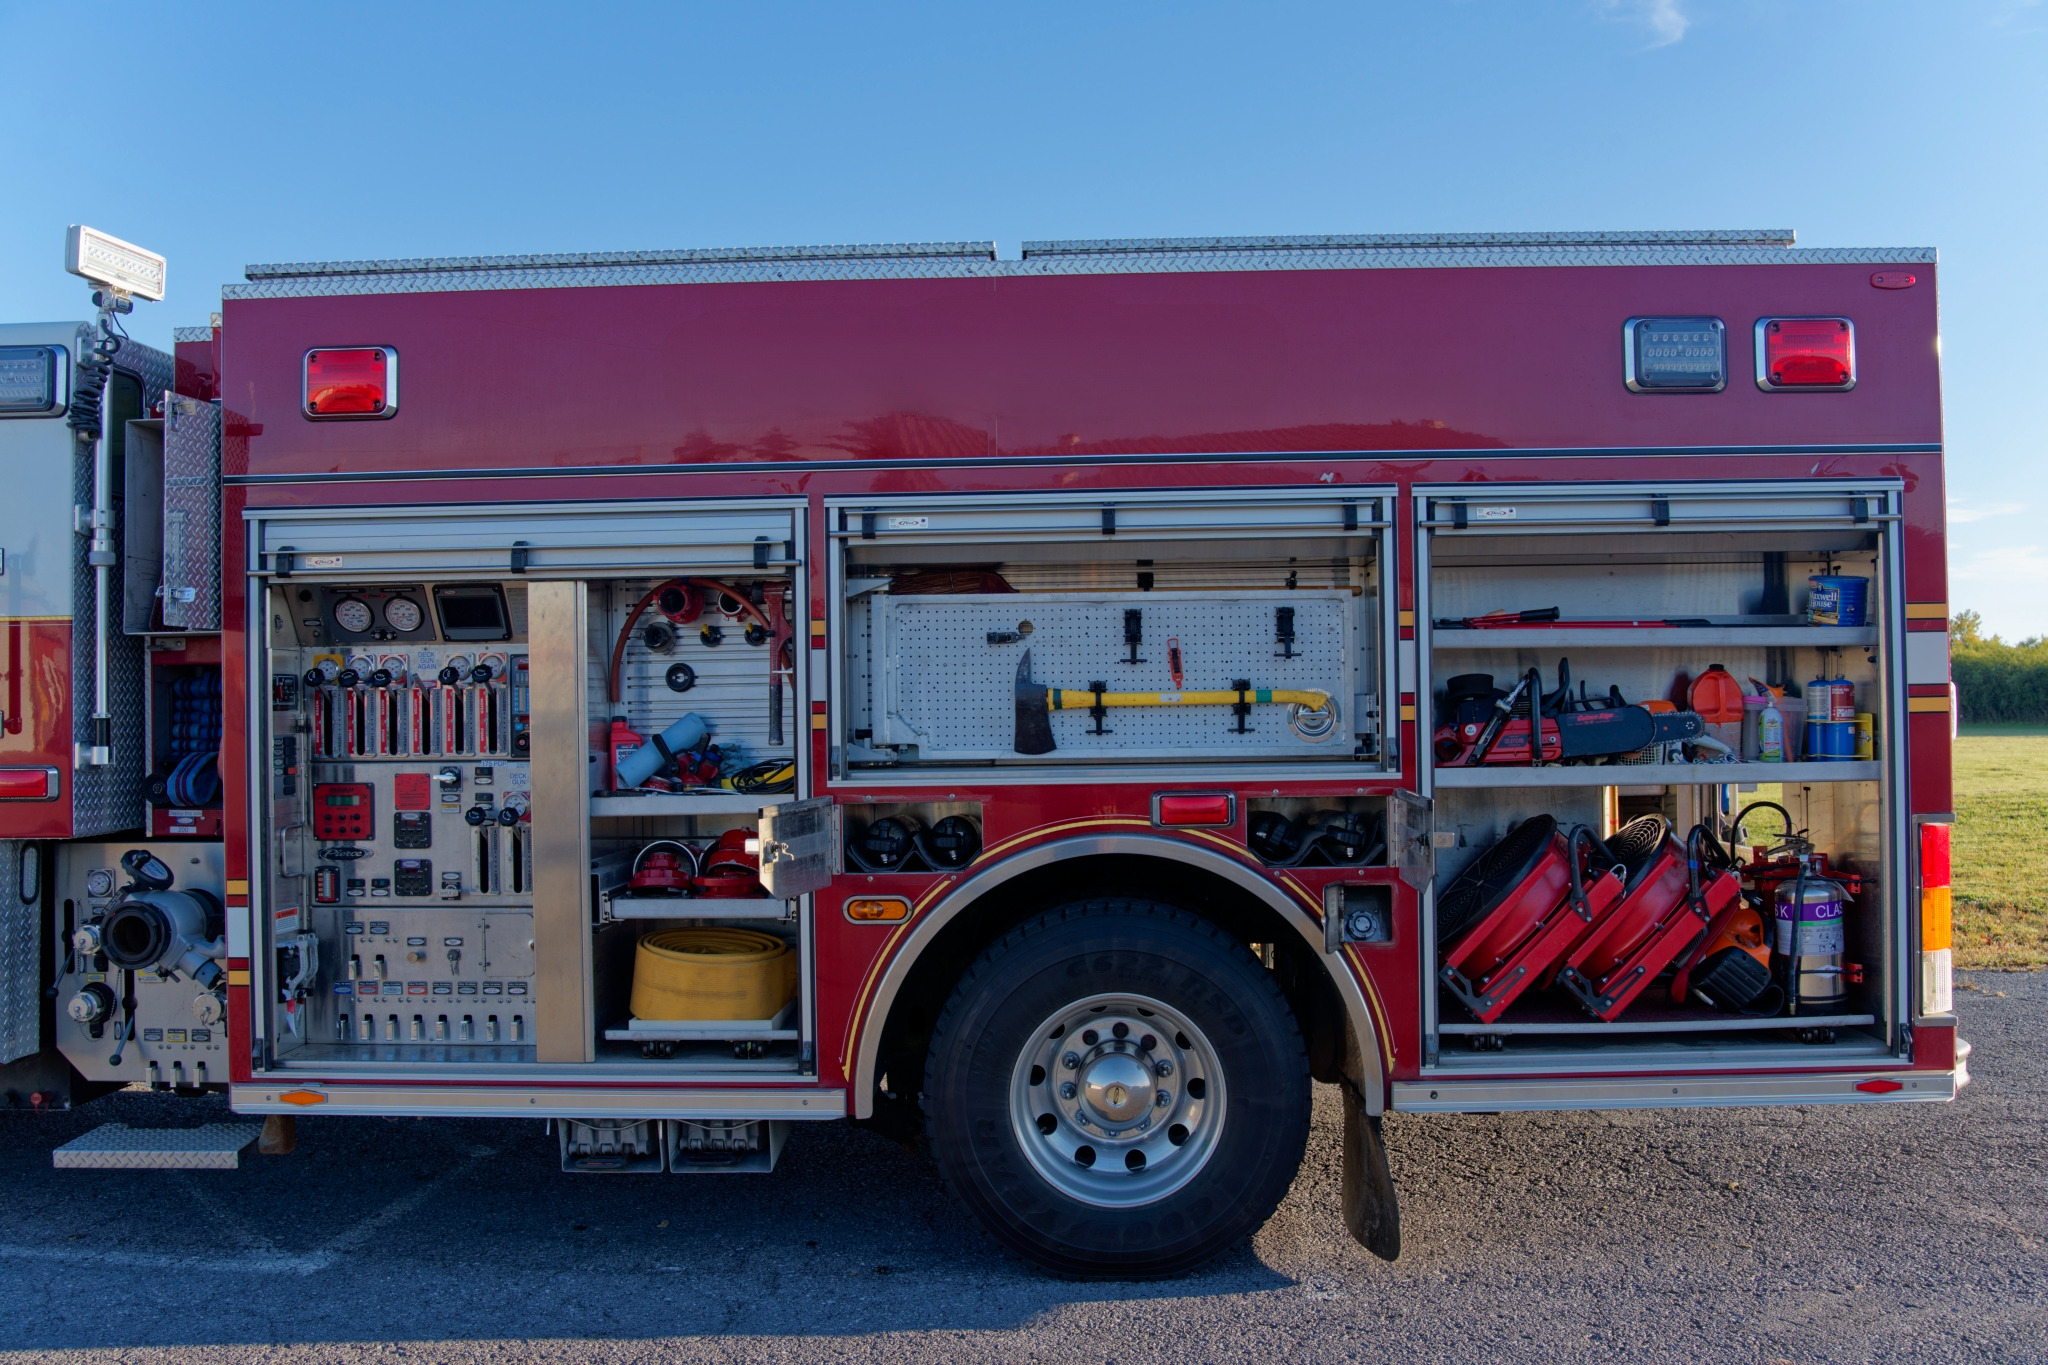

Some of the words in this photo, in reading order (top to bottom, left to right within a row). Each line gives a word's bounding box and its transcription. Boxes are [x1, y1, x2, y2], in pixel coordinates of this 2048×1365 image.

[1809, 590, 1837, 601] Maxwell
[1810, 599, 1832, 608] House
[324, 848, 363, 858] Pierce
